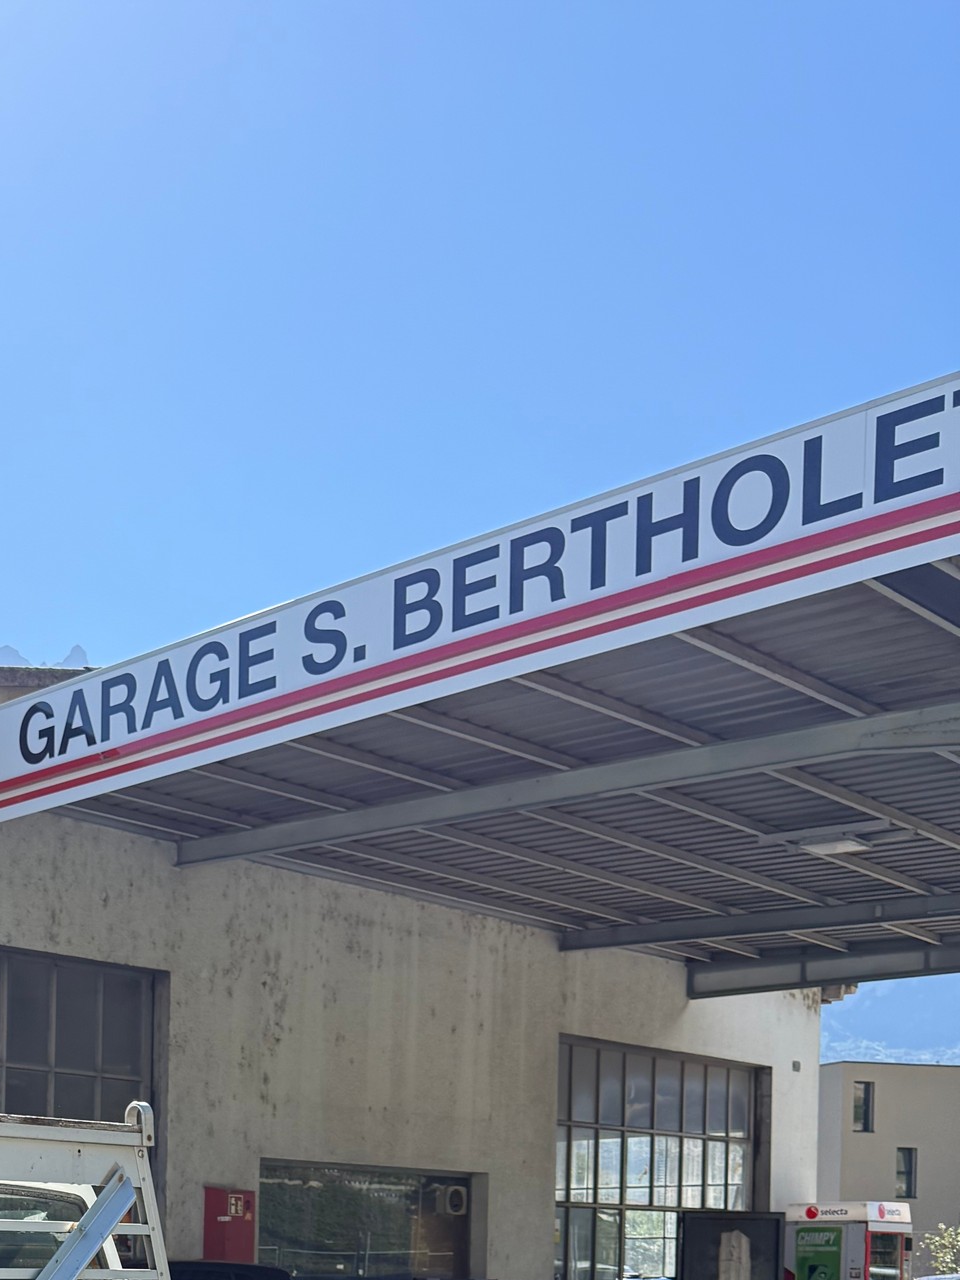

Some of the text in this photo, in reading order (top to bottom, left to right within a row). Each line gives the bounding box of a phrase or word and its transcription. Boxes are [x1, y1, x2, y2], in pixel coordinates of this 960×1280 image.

[19, 390, 960, 765] GARAGE S. BERTHOLE
[820, 1208, 848, 1216] selecta
[797, 1232, 836, 1244] CHIMPY
